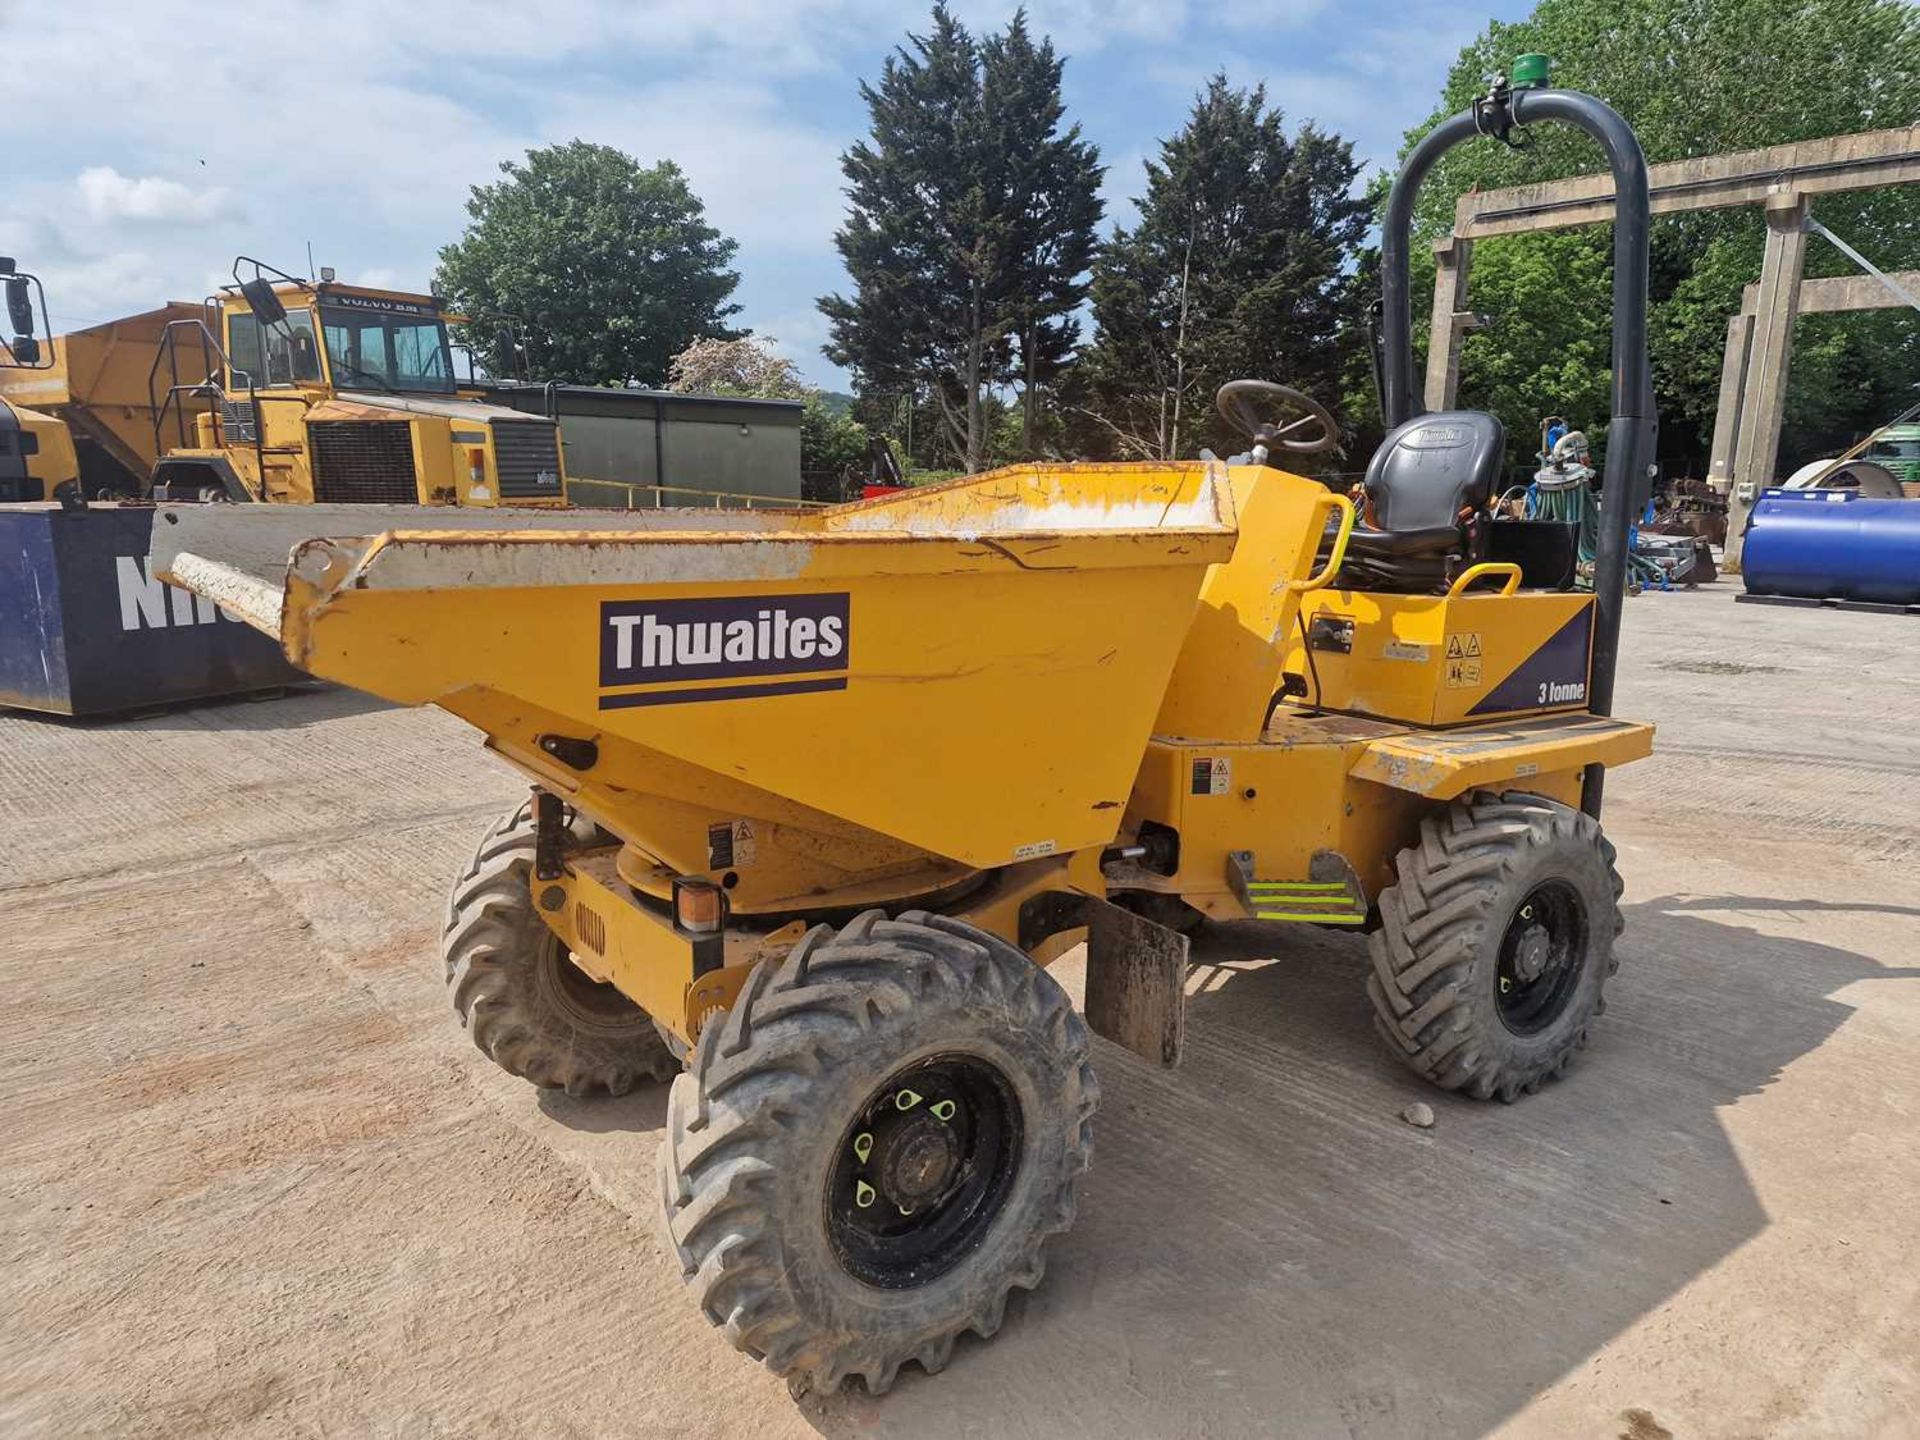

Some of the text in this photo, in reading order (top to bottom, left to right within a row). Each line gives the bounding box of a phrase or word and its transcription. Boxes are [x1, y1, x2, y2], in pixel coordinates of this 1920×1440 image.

[341, 298, 391, 310] VOLVO
[609, 609, 843, 669] Thwaites
[1538, 681, 1585, 704] 3 tonne
